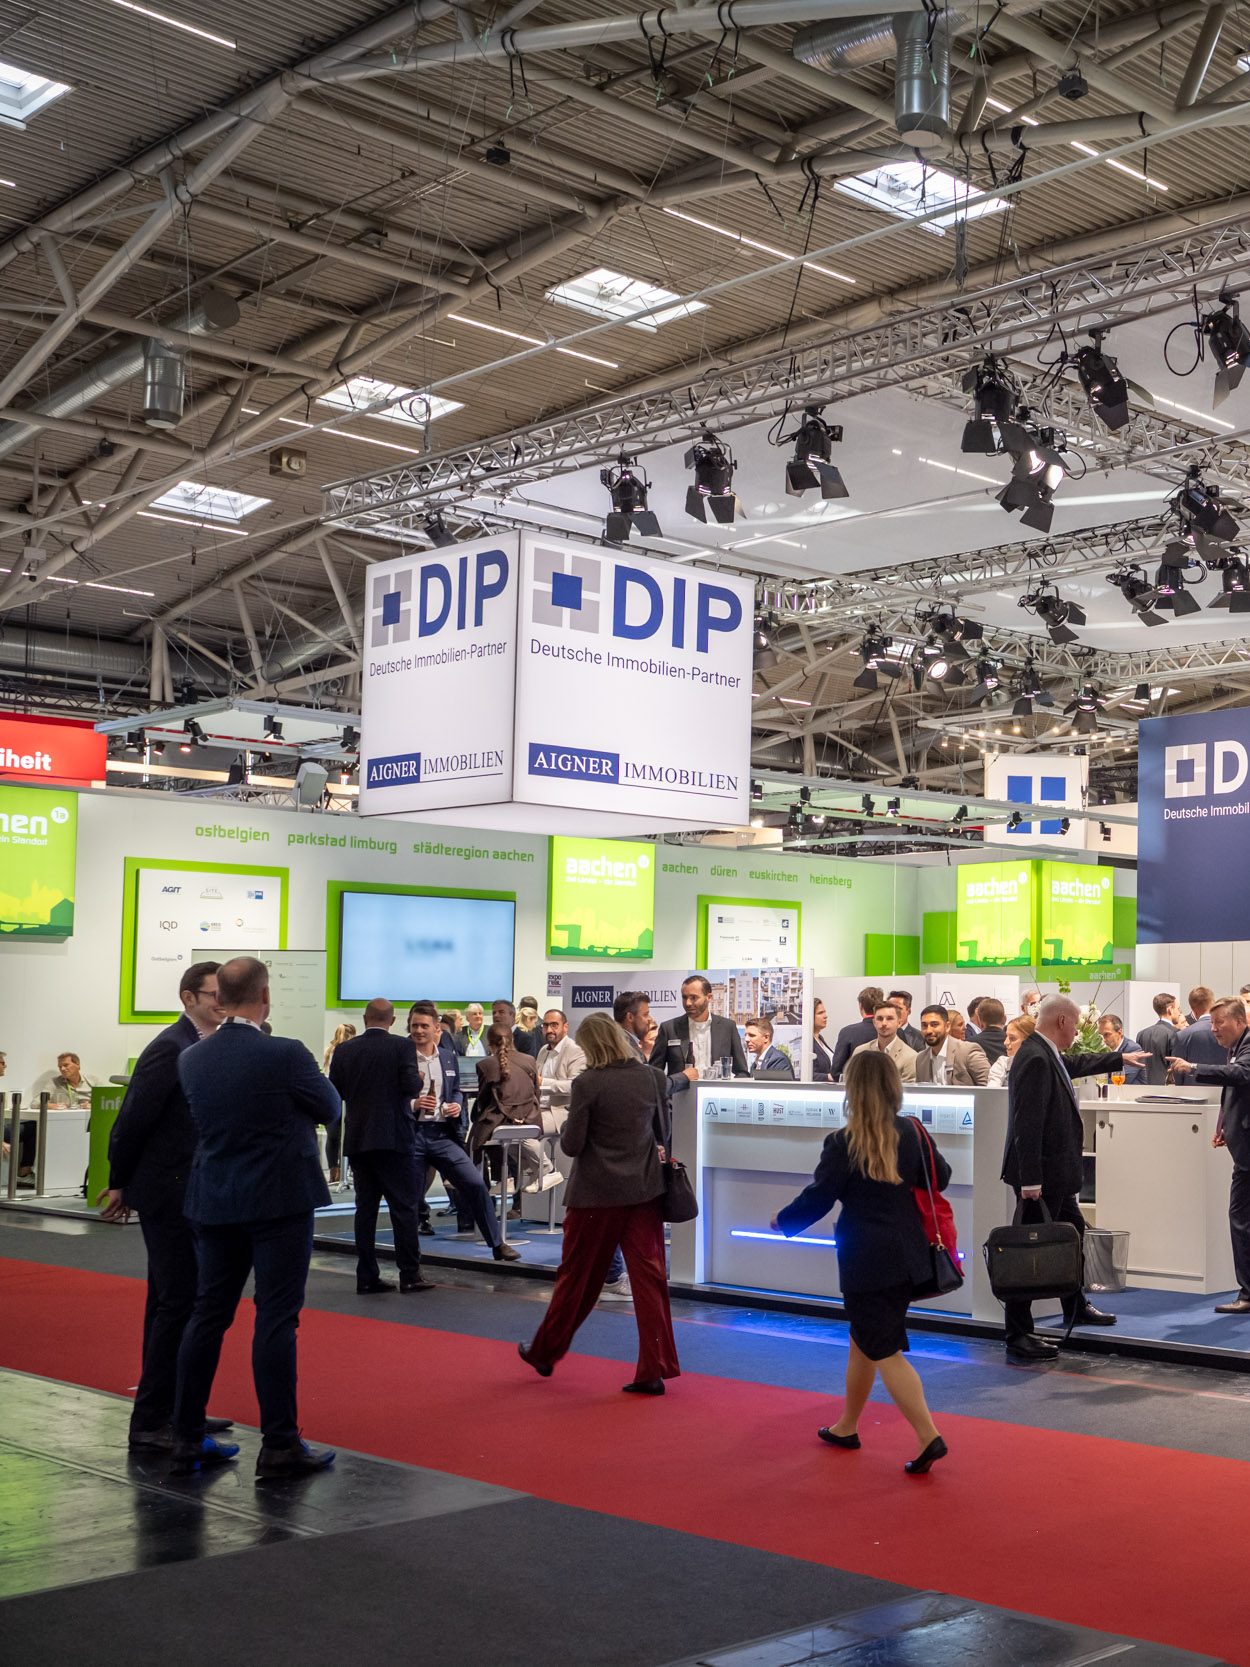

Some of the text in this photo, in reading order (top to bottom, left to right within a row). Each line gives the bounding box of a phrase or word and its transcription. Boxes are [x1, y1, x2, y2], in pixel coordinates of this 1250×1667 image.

[419, 549, 509, 637] DIP
[613, 564, 742, 653] DIP
[370, 640, 507, 677] Deutsche Immobilien-Partner
[530, 638, 741, 689] Deutsche Immobilien-Partner
[369, 750, 504, 783] AIGNER IMMOBILIEN
[534, 751, 739, 791] AIGNER IMMOBILIEN
[1164, 804, 1208, 820] Deutsche
[195, 825, 535, 862] ostbelgien parkstad limburg städteregion aachen
[565, 855, 637, 879] aachen
[662, 863, 852, 889] aachen düren euskirchen heinsberg
[966, 877, 1018, 897] aachen
[1052, 878, 1101, 898] aachen
[160, 921, 178, 931] IQD
[1089, 971, 1116, 980] aachen
[574, 990, 611, 1003] AIGNER
[101, 1096, 121, 1110] inf
